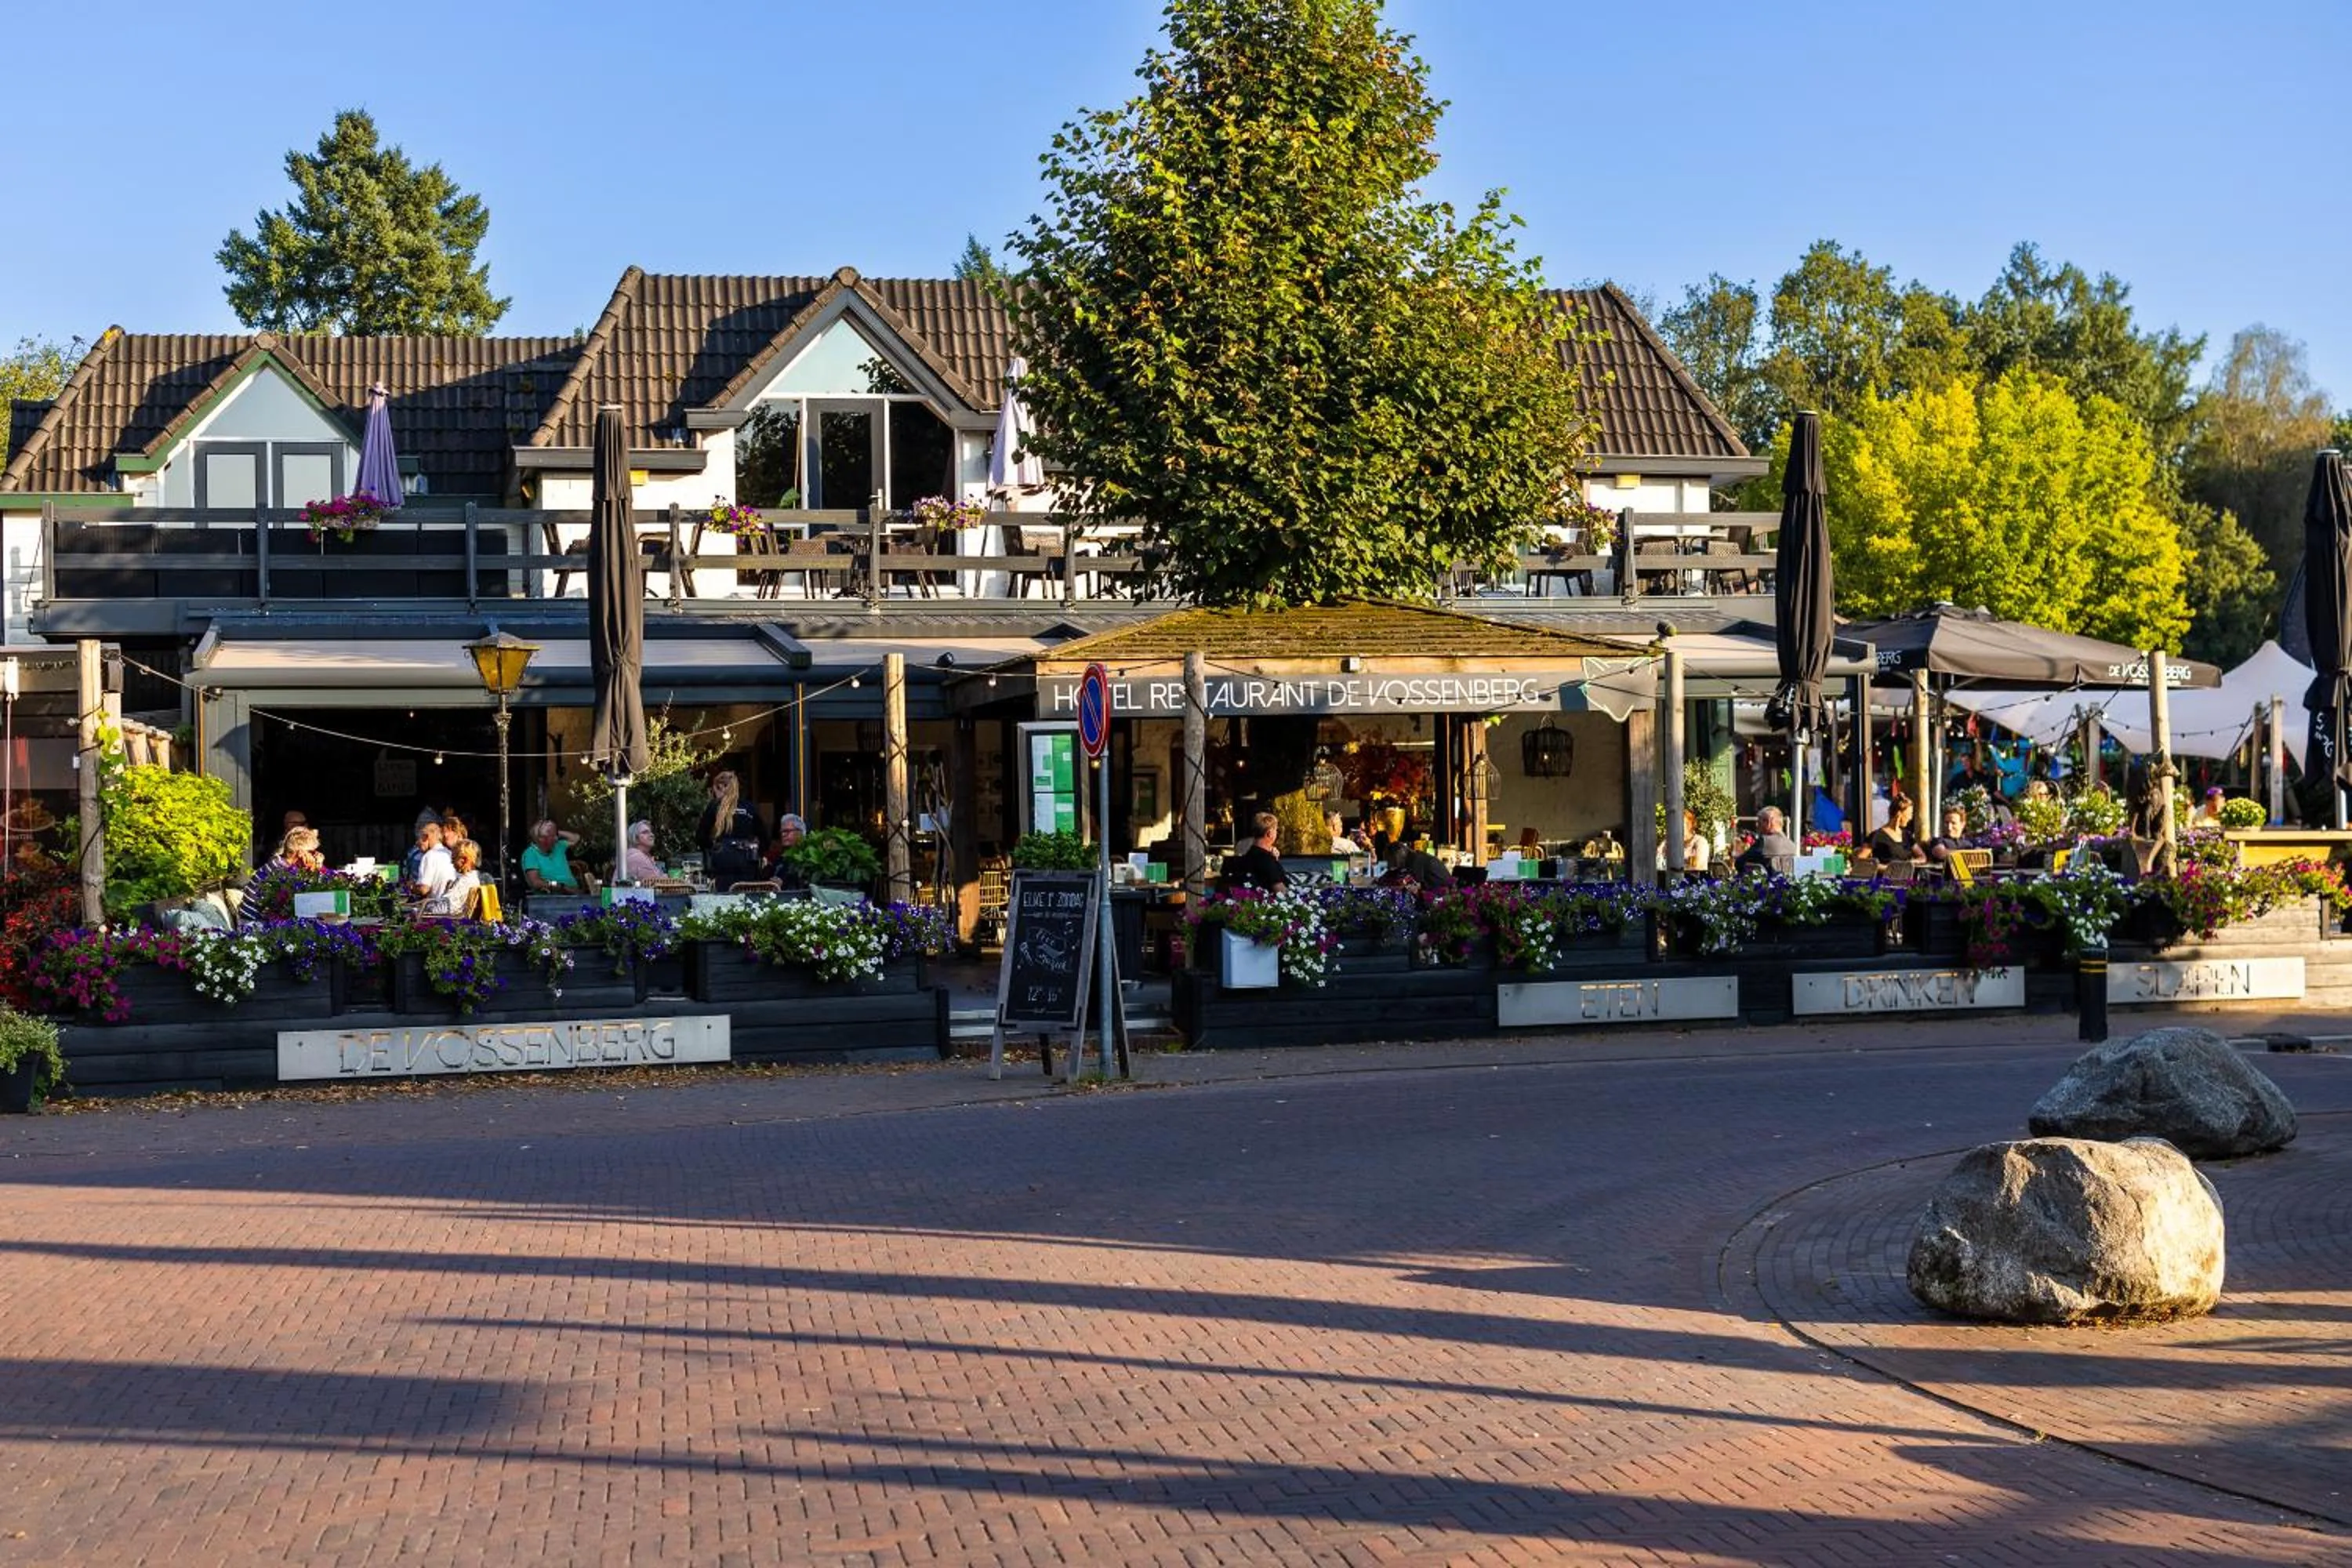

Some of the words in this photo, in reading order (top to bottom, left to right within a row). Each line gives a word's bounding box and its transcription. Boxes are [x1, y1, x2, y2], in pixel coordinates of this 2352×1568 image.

[1054, 683, 1144, 711] HEL
[1150, 681, 1319, 710] RETAURANT
[1328, 681, 1362, 706] DE
[1369, 678, 1540, 707] VOSSENBERG
[1843, 971, 1975, 1009] DRINKEN
[2136, 963, 2250, 997] SLAPEN
[1581, 982, 1658, 1018] ETEN
[339, 1031, 391, 1073] DE
[405, 1022, 676, 1070] VOSSENBERG
